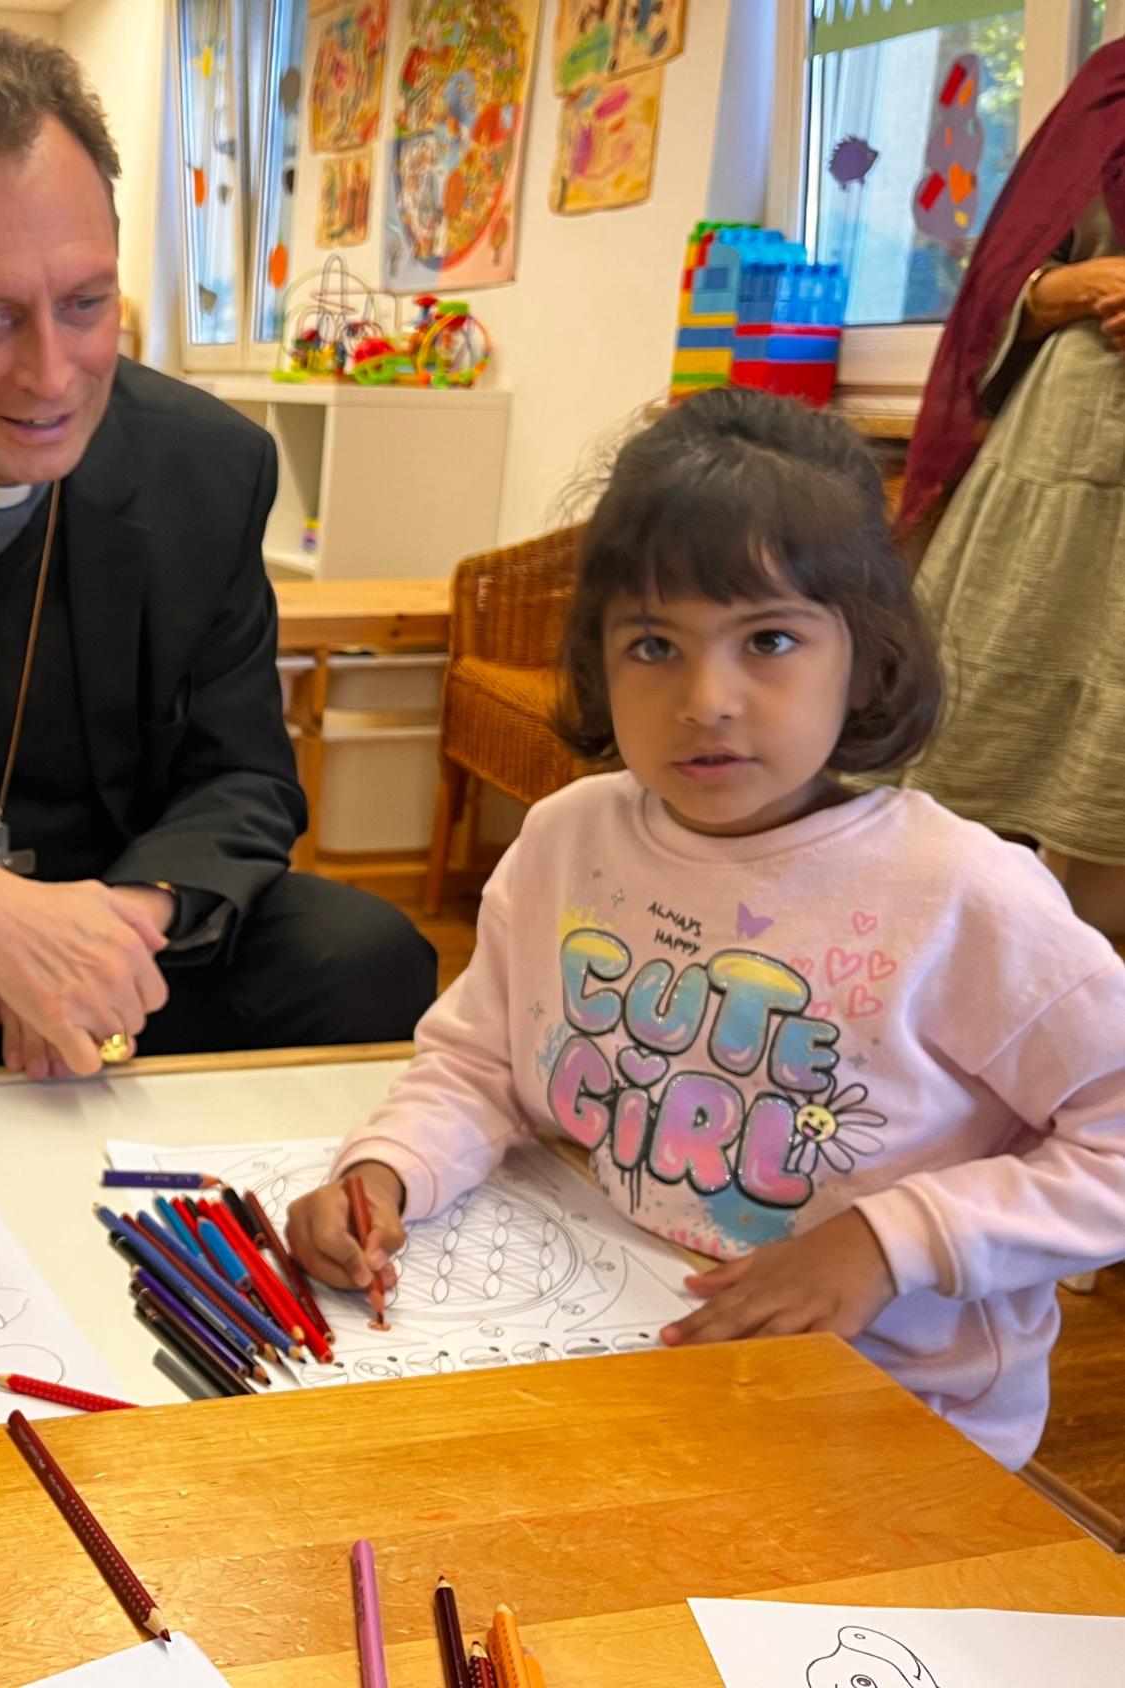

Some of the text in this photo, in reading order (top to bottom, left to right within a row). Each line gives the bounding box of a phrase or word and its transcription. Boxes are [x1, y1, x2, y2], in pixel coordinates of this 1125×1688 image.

[646, 901, 702, 938] ALWAYS
[654, 929, 701, 957] HAPPY
[560, 928, 840, 1093] CUTE
